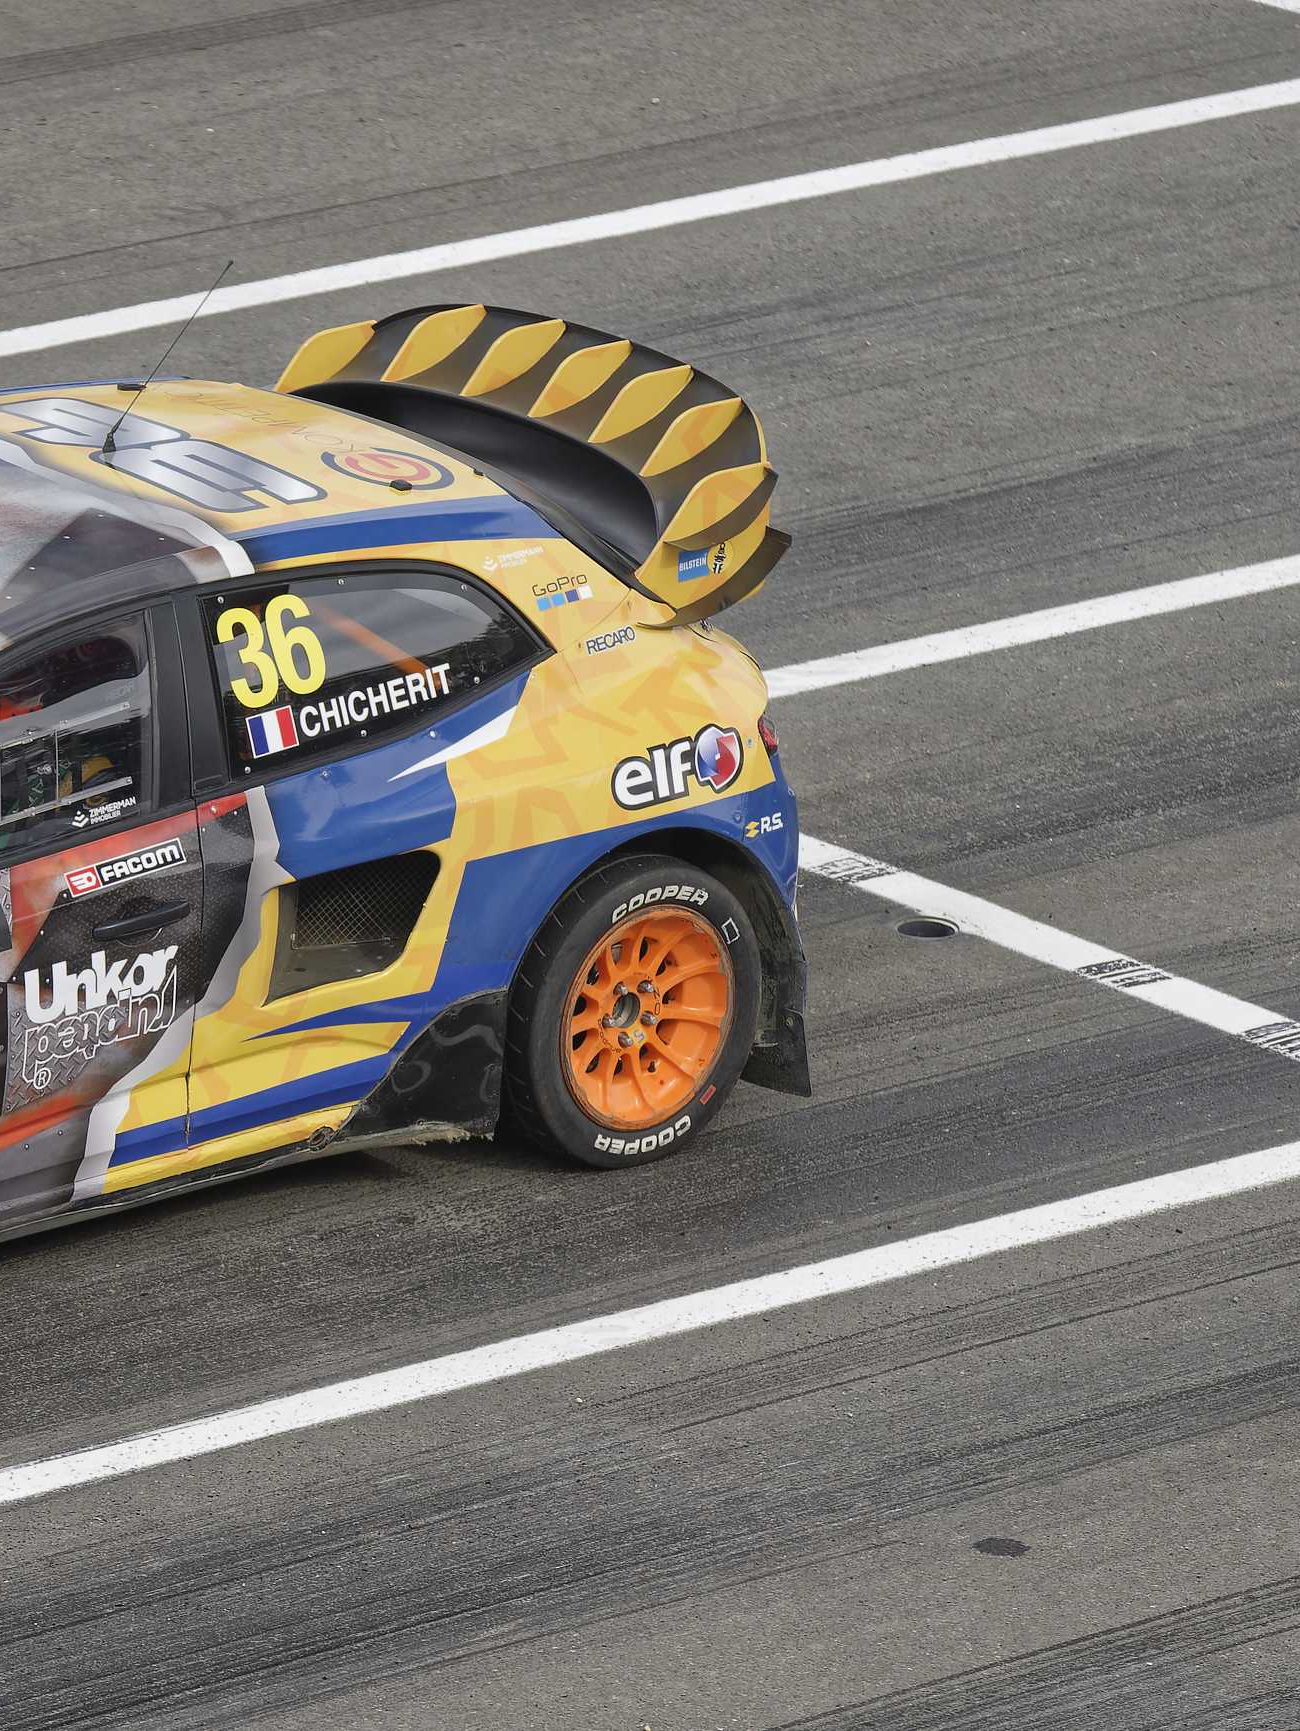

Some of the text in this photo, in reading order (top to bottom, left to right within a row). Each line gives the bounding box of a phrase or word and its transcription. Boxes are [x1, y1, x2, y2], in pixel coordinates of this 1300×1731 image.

[678, 554, 707, 573] BILSTEIN
[532, 574, 588, 597] GoPro
[216, 594, 326, 708] 36
[585, 626, 636, 655] RECARO
[300, 663, 450, 737] CHICHERIT
[614, 742, 693, 807] elf
[89, 796, 136, 818] ZIMMERMAN
[760, 812, 783, 834] R.S.
[100, 844, 180, 882] FACOM
[612, 885, 709, 924] COOPER
[594, 1114, 692, 1155] COOPER
